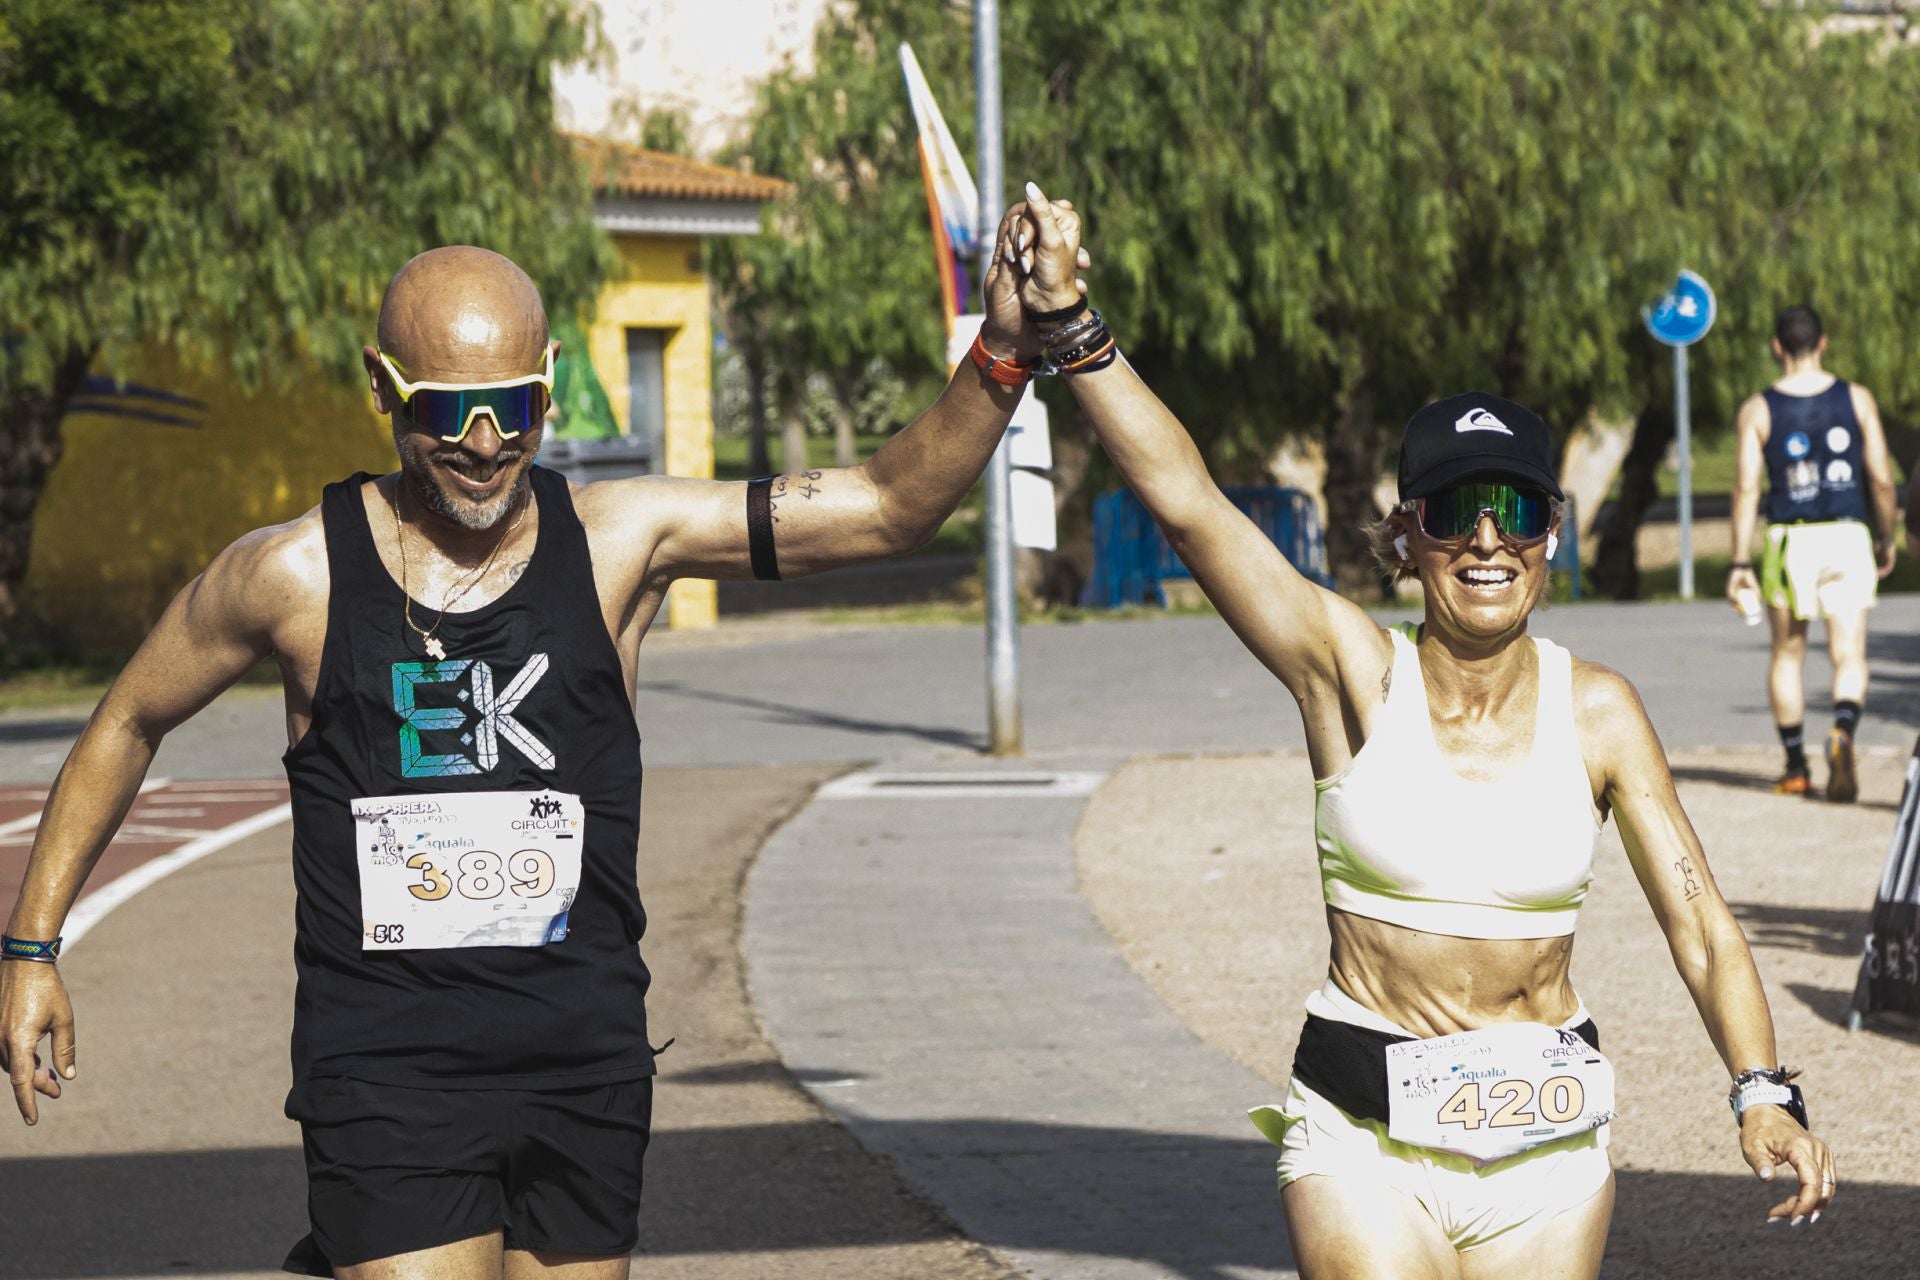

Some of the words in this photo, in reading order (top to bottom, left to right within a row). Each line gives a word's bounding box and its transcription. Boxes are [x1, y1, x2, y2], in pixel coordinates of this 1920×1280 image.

[798, 471, 822, 500] 48
[511, 818, 569, 830] CIRCUIT
[424, 837, 475, 851] aqualia
[406, 848, 555, 901] 389
[373, 924, 404, 943] 5K
[1458, 1067, 1507, 1082] aqualia
[1437, 1075, 1585, 1130] 420
